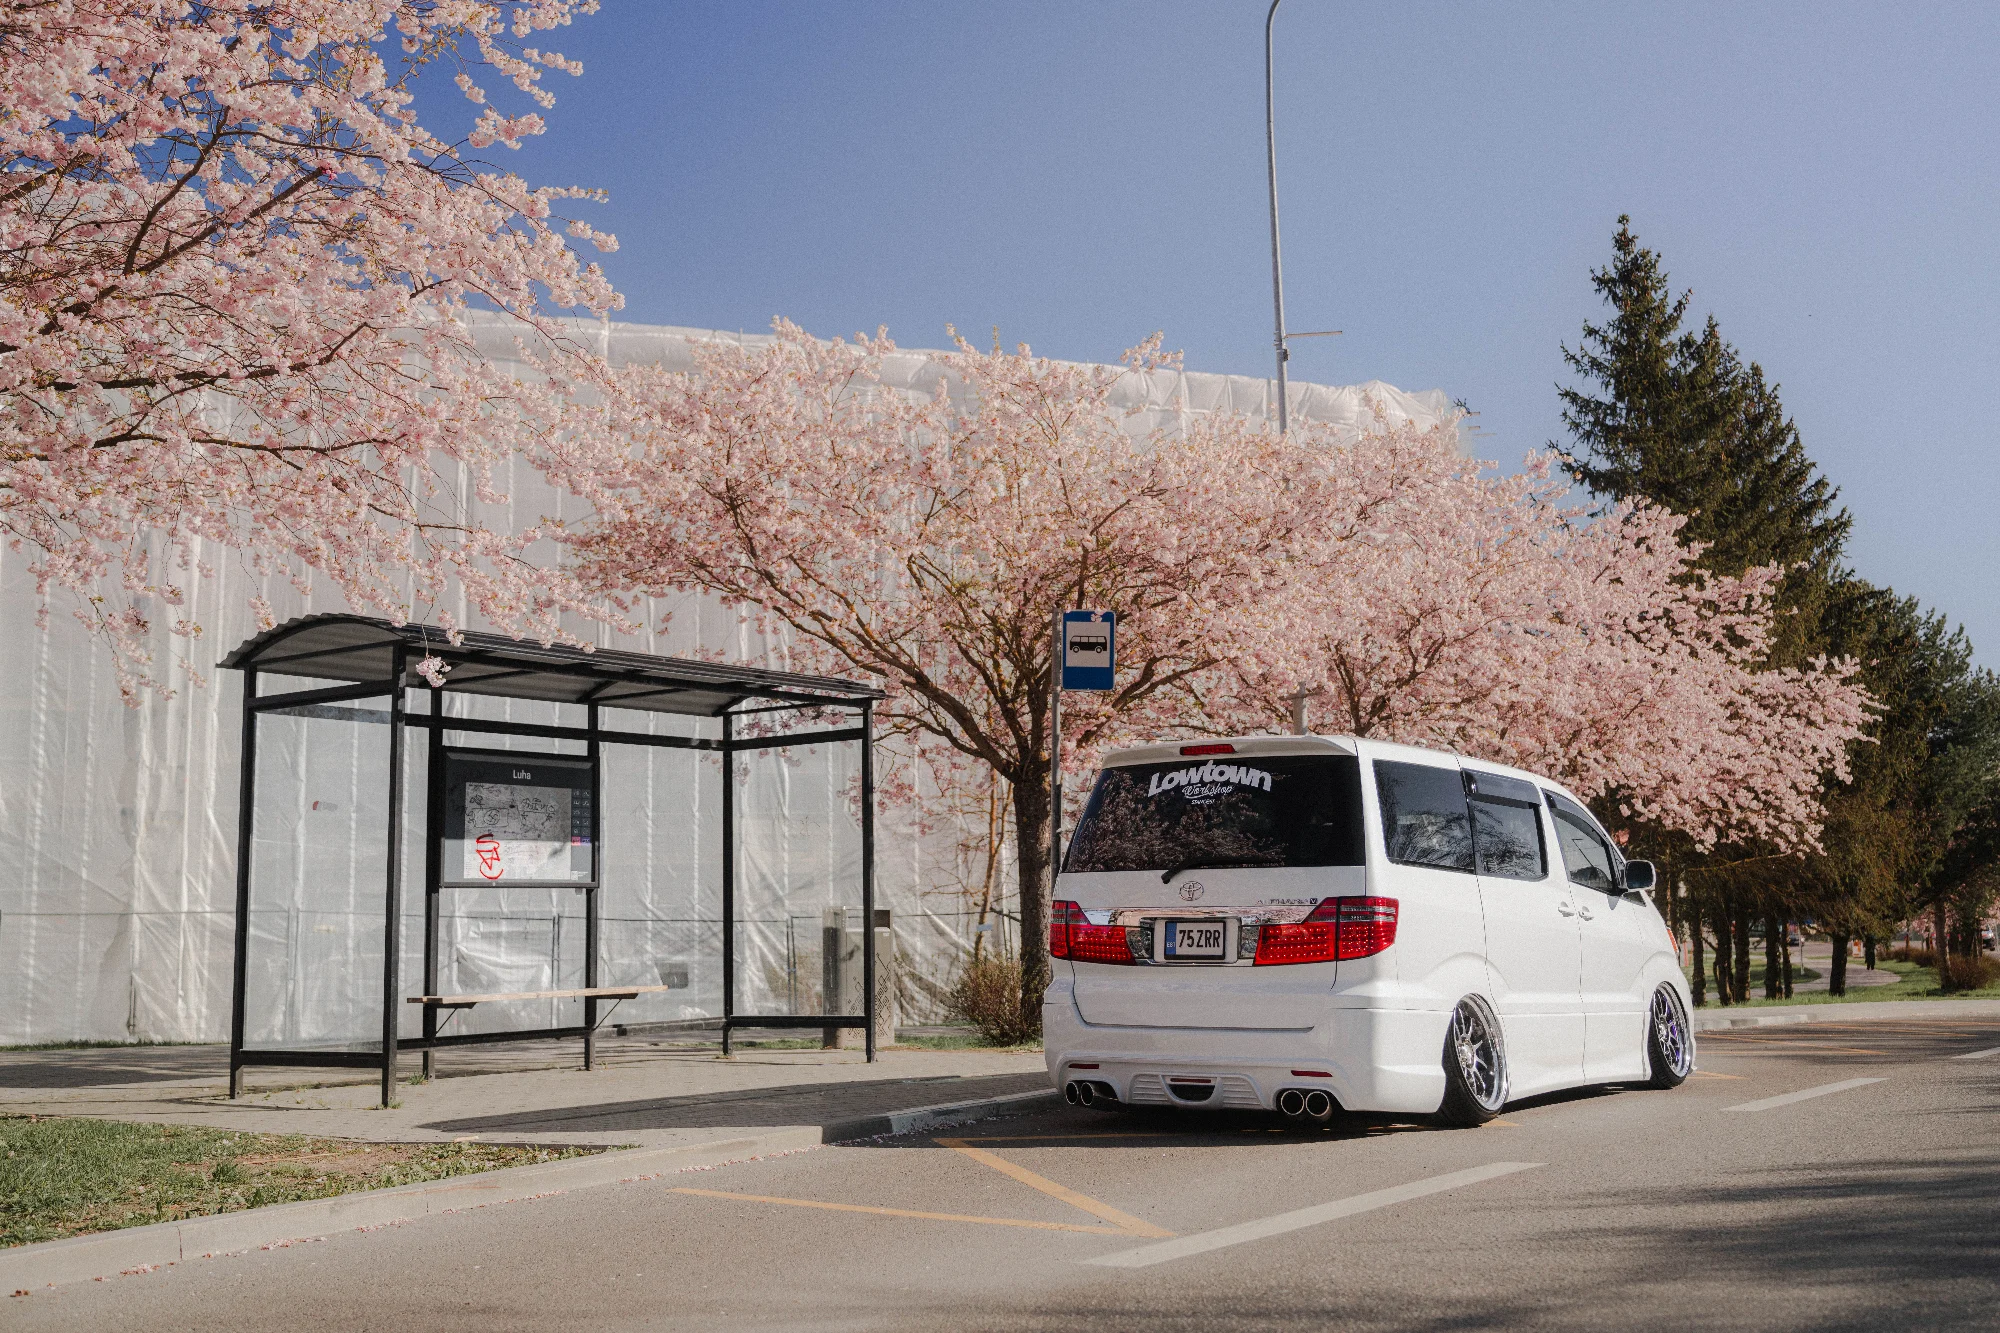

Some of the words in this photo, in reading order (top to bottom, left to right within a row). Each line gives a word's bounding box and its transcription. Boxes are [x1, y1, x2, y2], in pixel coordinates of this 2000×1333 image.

[512, 769, 531, 780] Luha
[1147, 760, 1272, 798] Lowtown
[1178, 929, 1221, 948] 75ZRR
